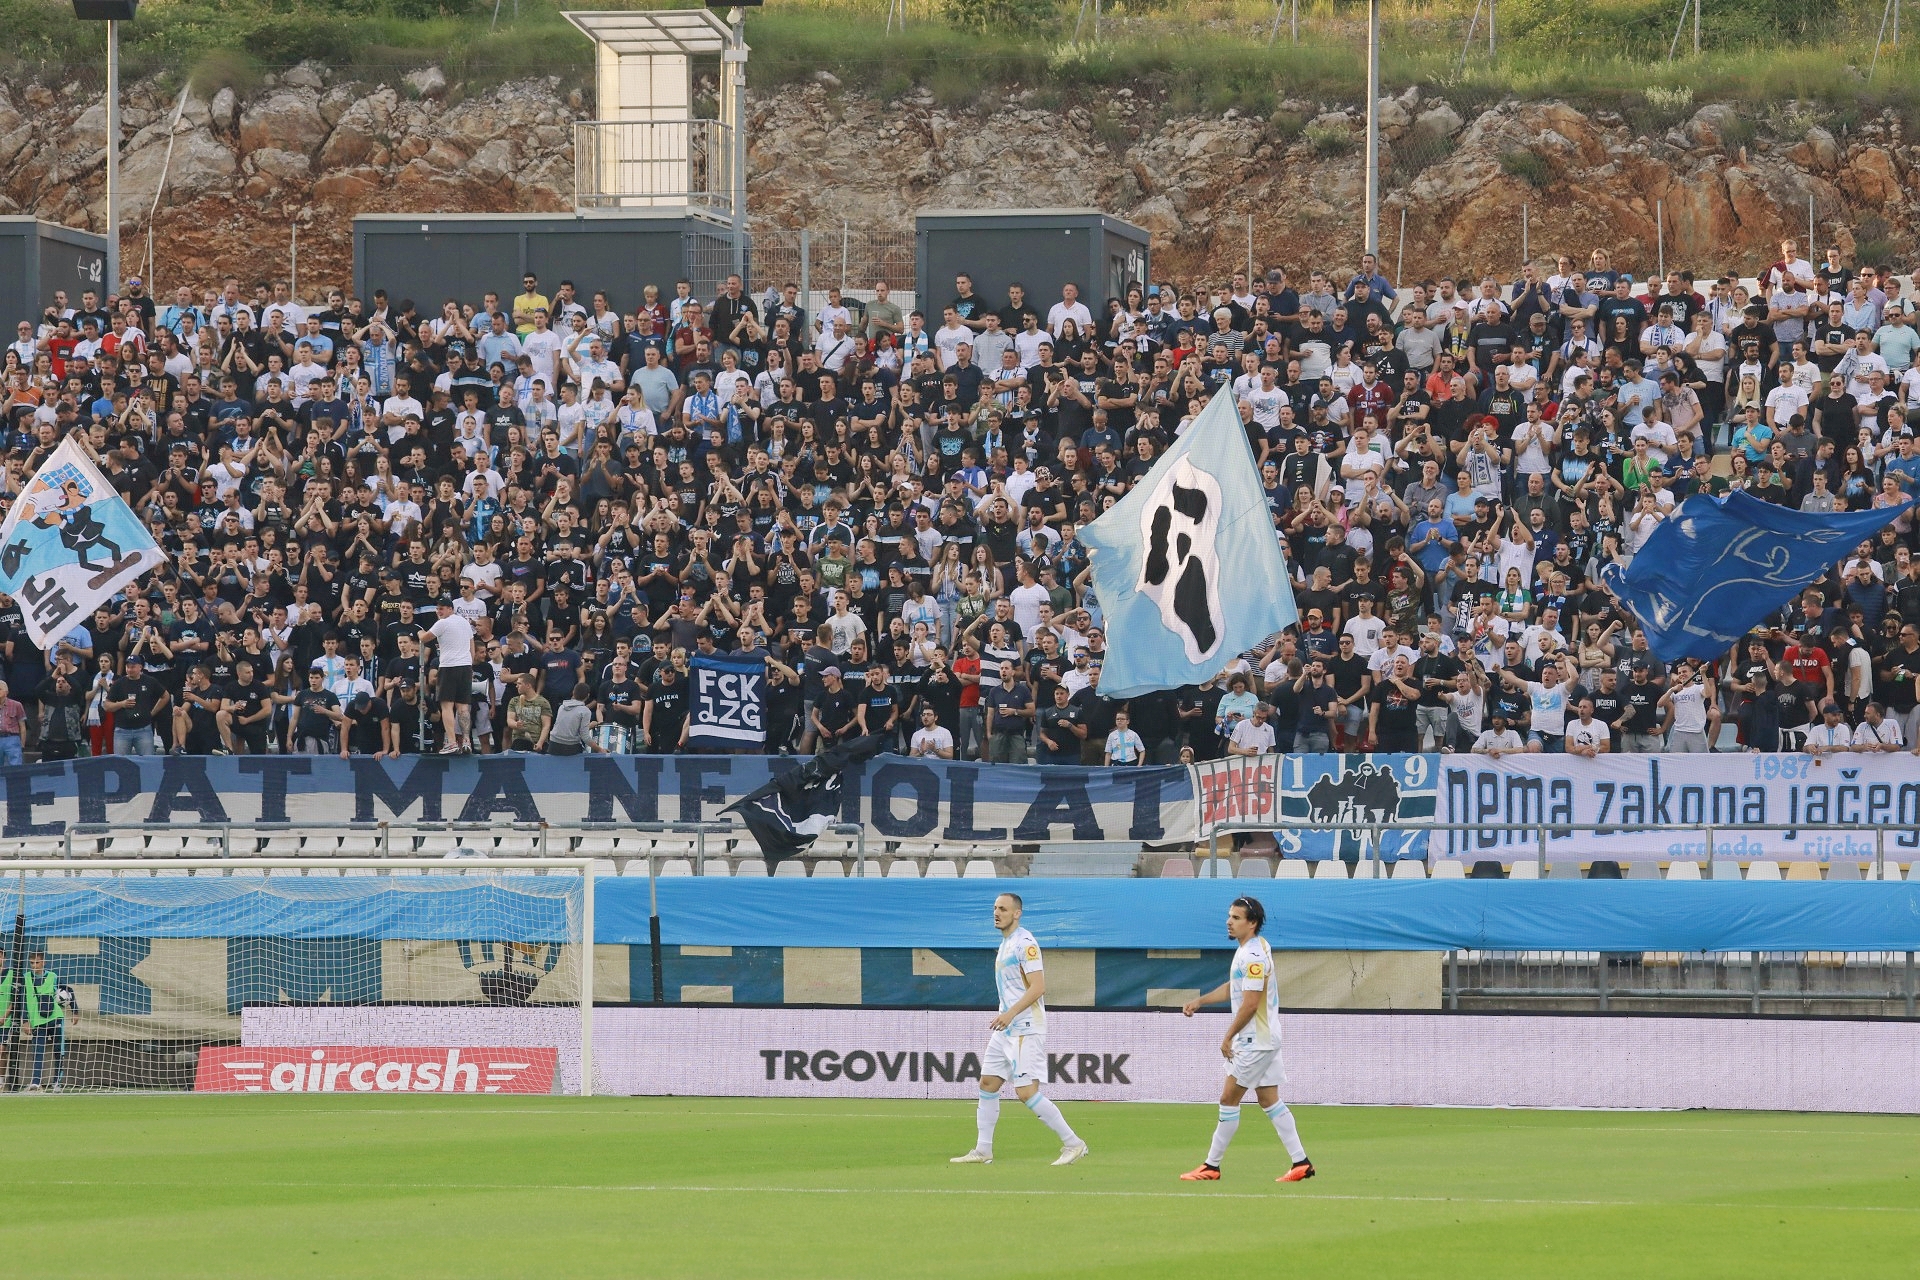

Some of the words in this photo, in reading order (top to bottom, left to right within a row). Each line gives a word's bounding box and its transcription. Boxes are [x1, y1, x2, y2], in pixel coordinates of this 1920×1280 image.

[90, 259, 101, 282] s2
[699, 669, 760, 702] FCK
[1286, 756, 1305, 789] 1
[1404, 754, 1429, 788] 9
[1752, 754, 1814, 781] 1987
[350, 757, 546, 831] MA
[581, 757, 733, 833] NE
[1446, 767, 1573, 855] nema
[1594, 759, 1767, 837] zakona
[1667, 834, 1764, 856] armada
[1803, 834, 1873, 863] rijeka
[269, 1049, 479, 1092] aircash
[760, 1050, 981, 1083] TRGOVINA
[1050, 1053, 1132, 1084] KRK
